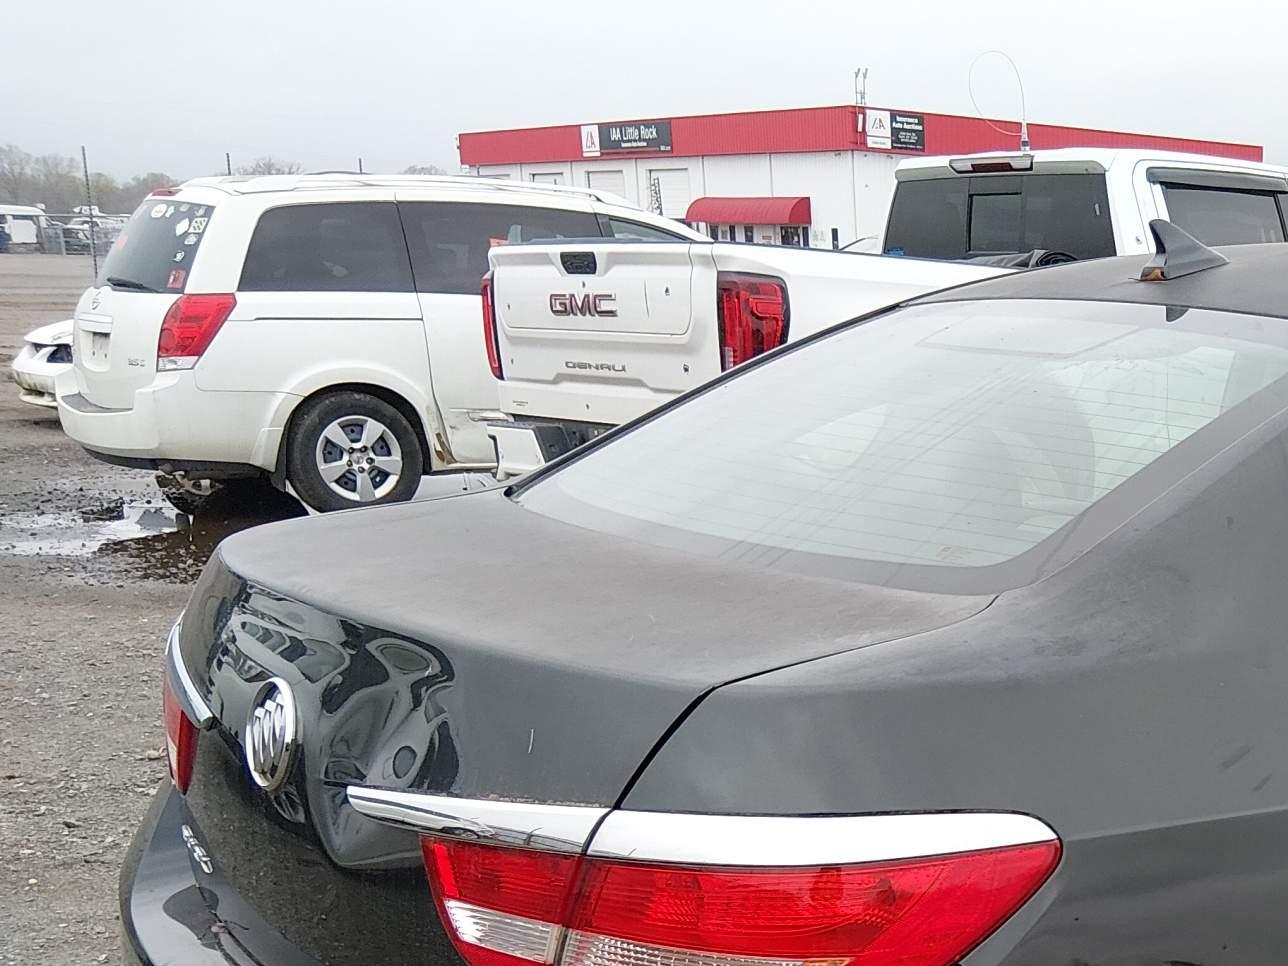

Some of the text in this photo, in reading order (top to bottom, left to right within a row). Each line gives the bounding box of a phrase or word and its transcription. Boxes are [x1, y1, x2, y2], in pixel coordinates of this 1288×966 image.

[610, 125, 657, 140] IAA Little Rock
[550, 293, 618, 317] GMC
[565, 361, 626, 373] DENALI
